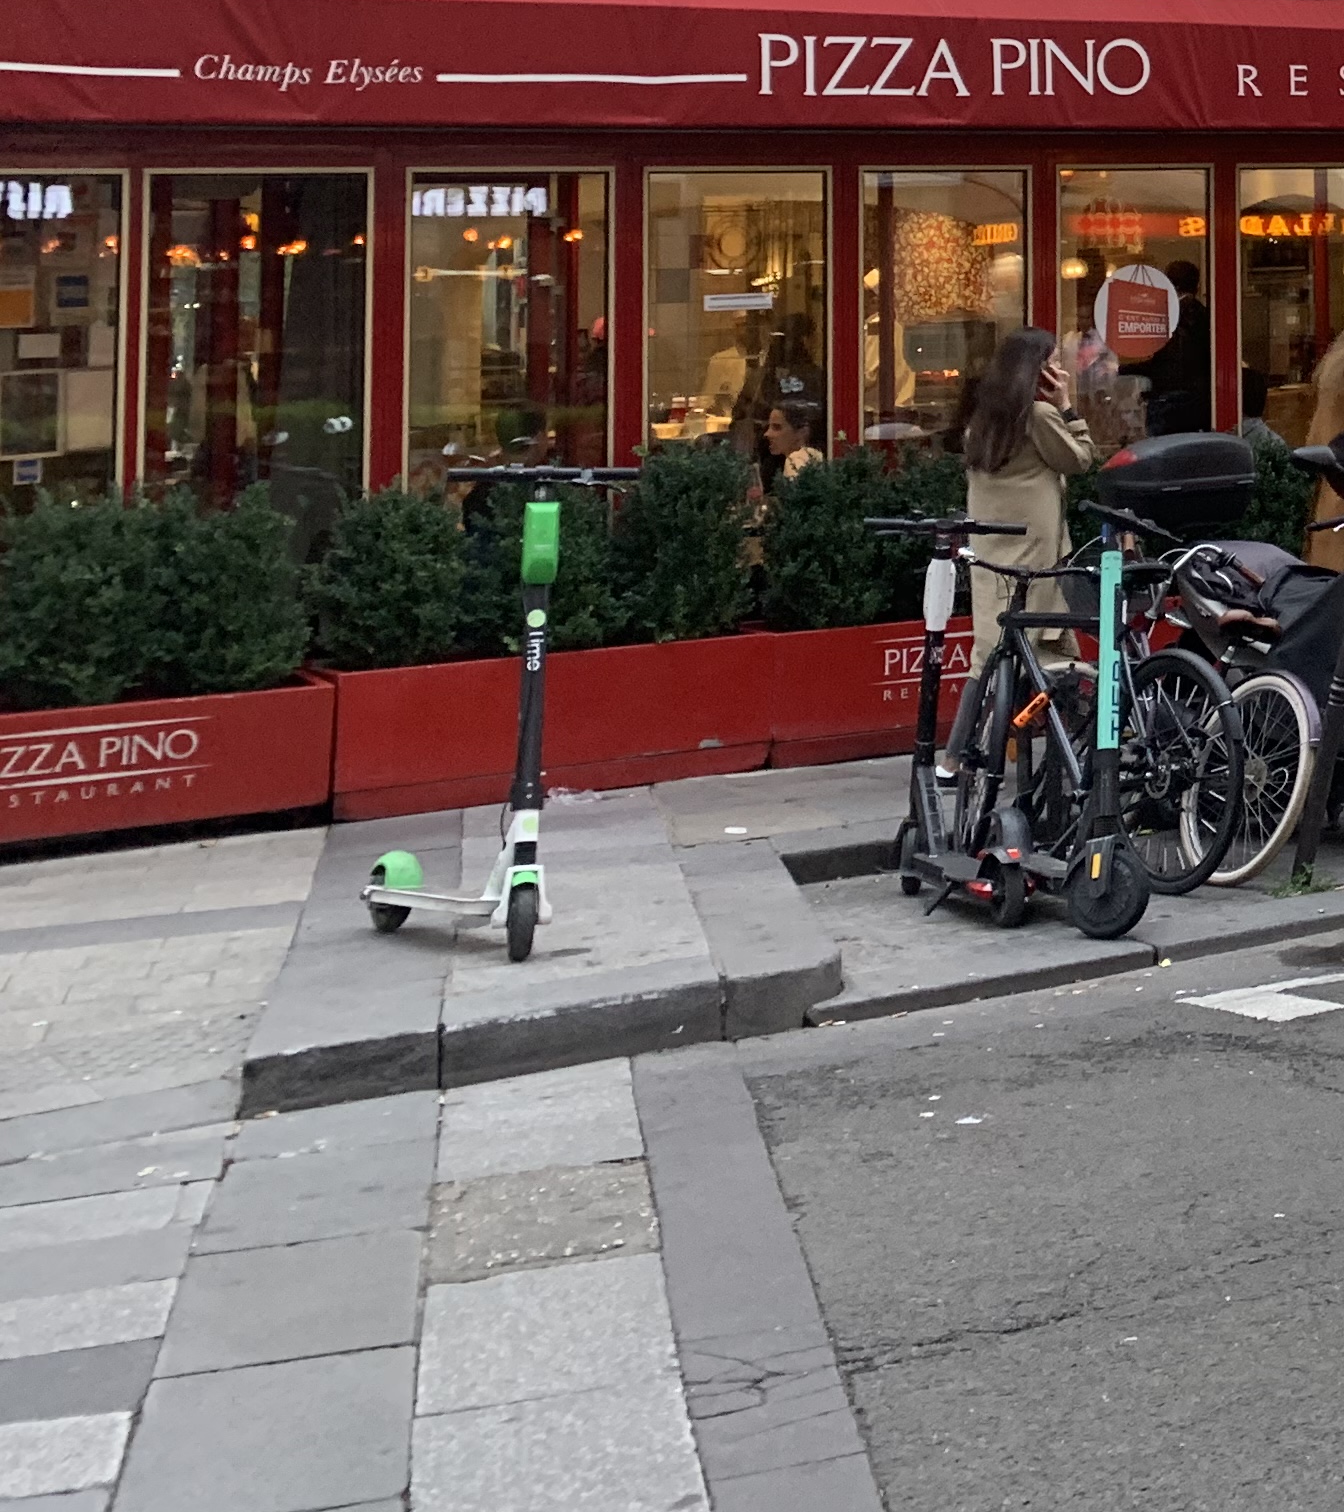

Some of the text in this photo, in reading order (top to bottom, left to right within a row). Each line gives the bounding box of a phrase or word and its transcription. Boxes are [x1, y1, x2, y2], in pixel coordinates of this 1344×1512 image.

[193, 53, 424, 91] Champs Elysées
[757, 32, 971, 98] PIZZA
[990, 37, 1151, 97] PINO
[1118, 321, 1167, 334] EMPORTER
[525, 631, 545, 672] lime
[884, 642, 970, 676] PIZA
[0, 728, 199, 779] ZZA PINO
[7, 773, 197, 809] STAURANT
